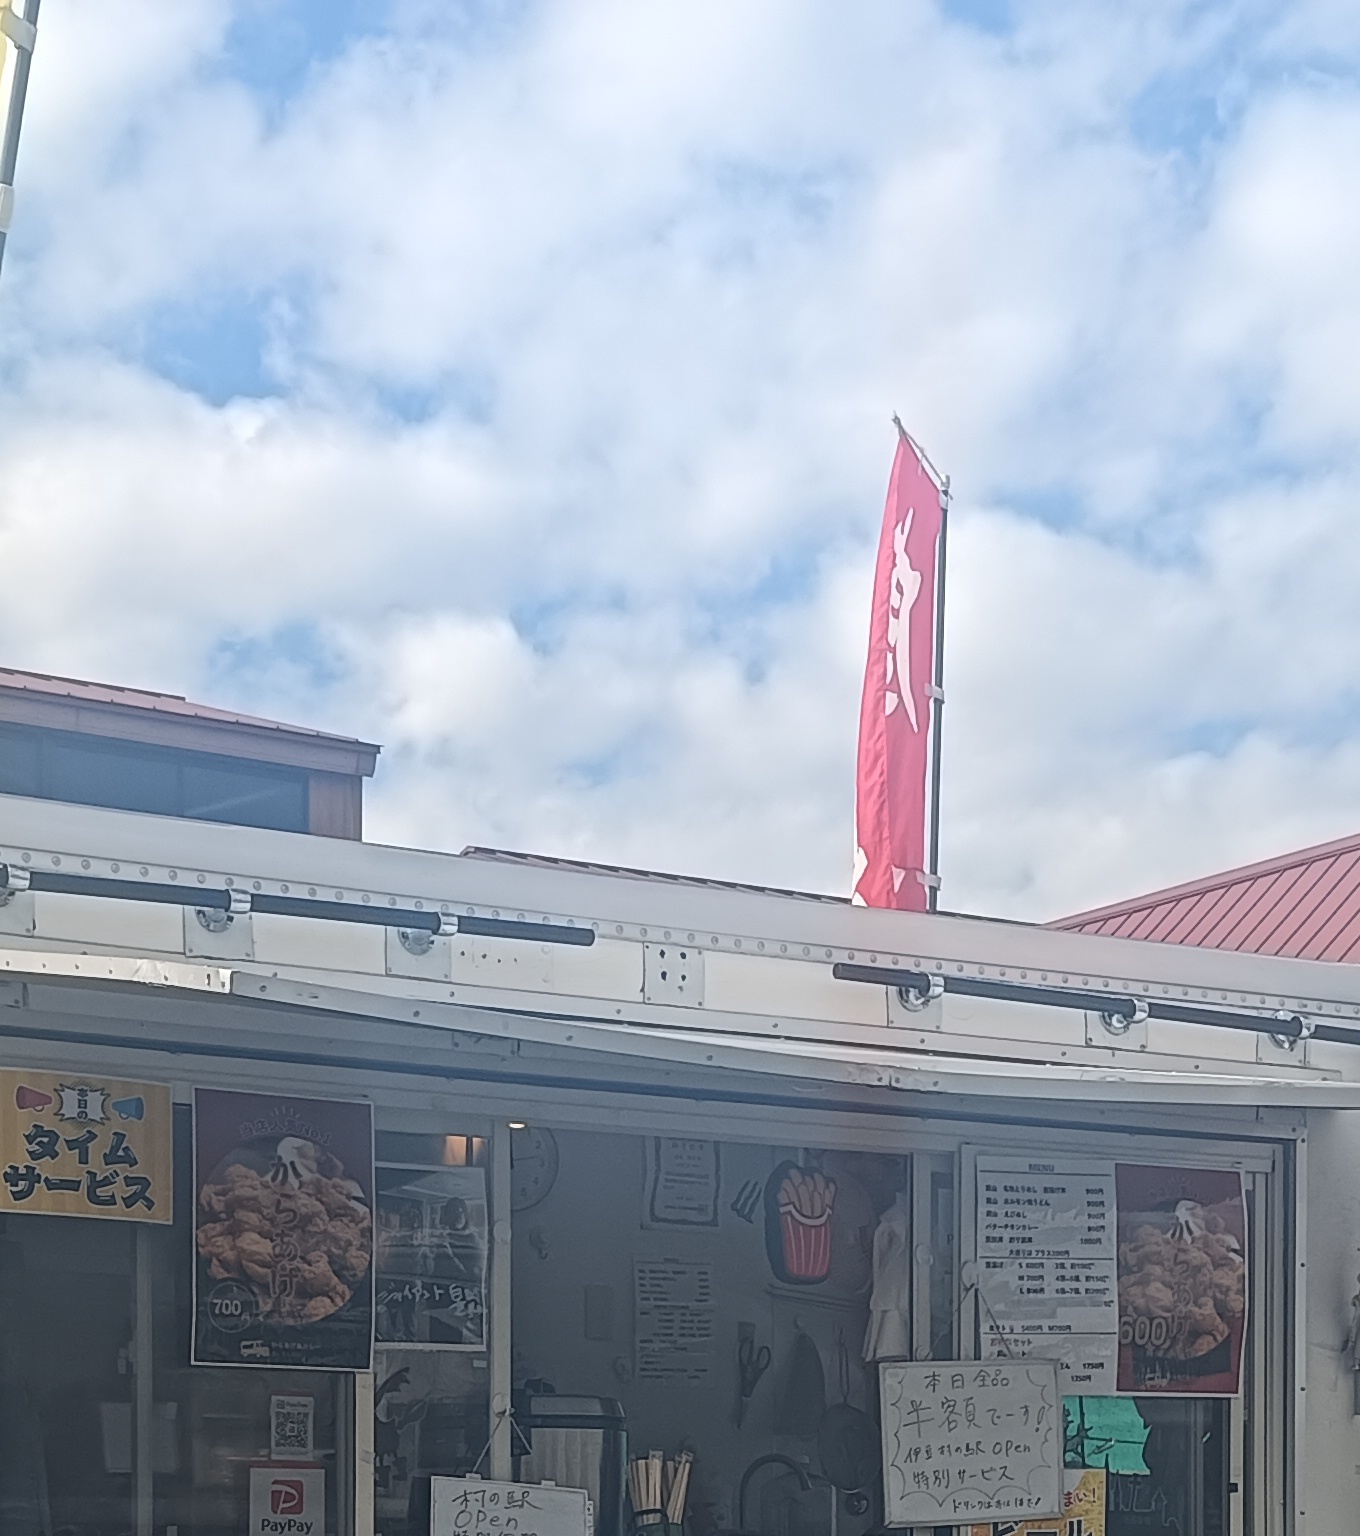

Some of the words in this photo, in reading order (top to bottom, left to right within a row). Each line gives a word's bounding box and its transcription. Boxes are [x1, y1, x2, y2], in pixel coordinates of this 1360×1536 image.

[22, 1123, 139, 1169] タイム
[3, 1163, 156, 1212] サービス
[269, 1154, 303, 1299] からあげ
[1120, 1315, 1167, 1346] 600
[912, 1465, 1015, 1490] 特別サービス
[452, 1489, 544, 1510] 村の駅
[260, 1518, 314, 1535] PayPay
